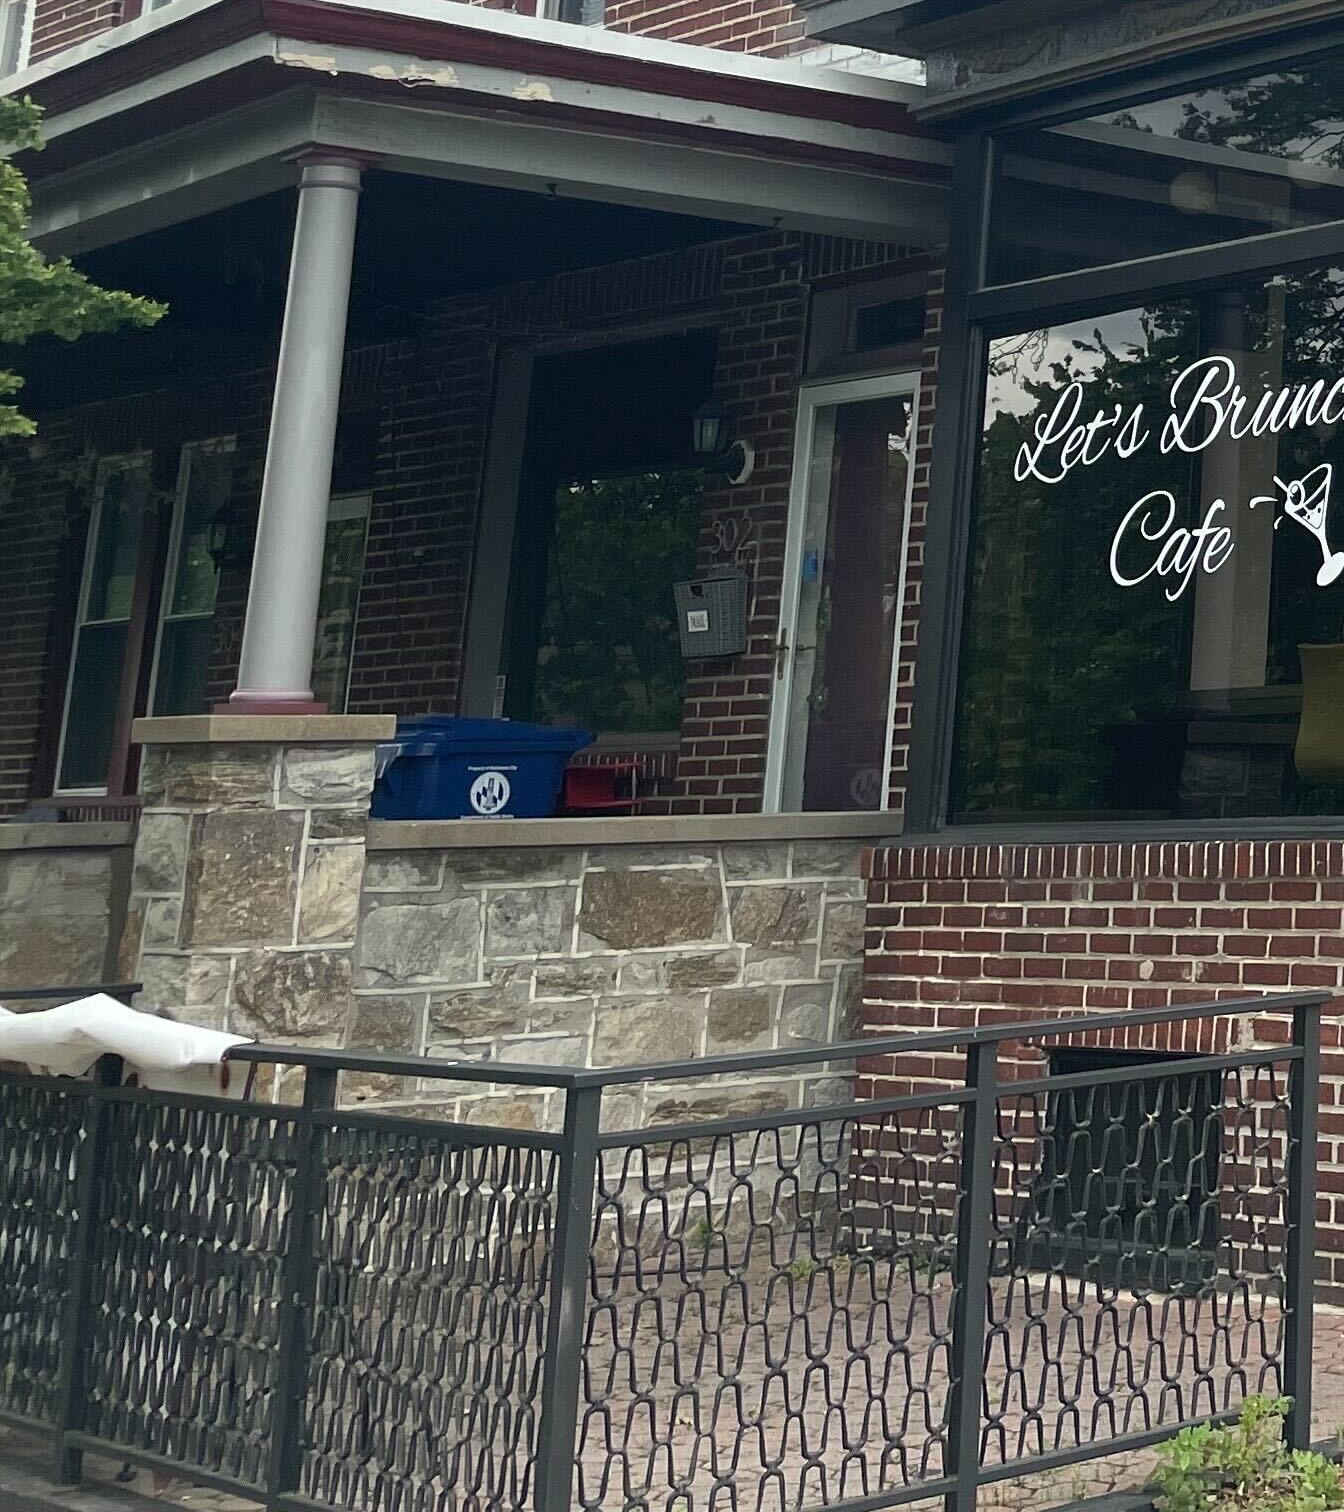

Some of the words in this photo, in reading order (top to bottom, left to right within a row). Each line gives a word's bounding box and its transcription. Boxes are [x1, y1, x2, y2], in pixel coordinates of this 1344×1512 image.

[1014, 382, 1149, 484] Let's
[711, 516, 754, 555] 302
[1110, 490, 1235, 601] Cafe
